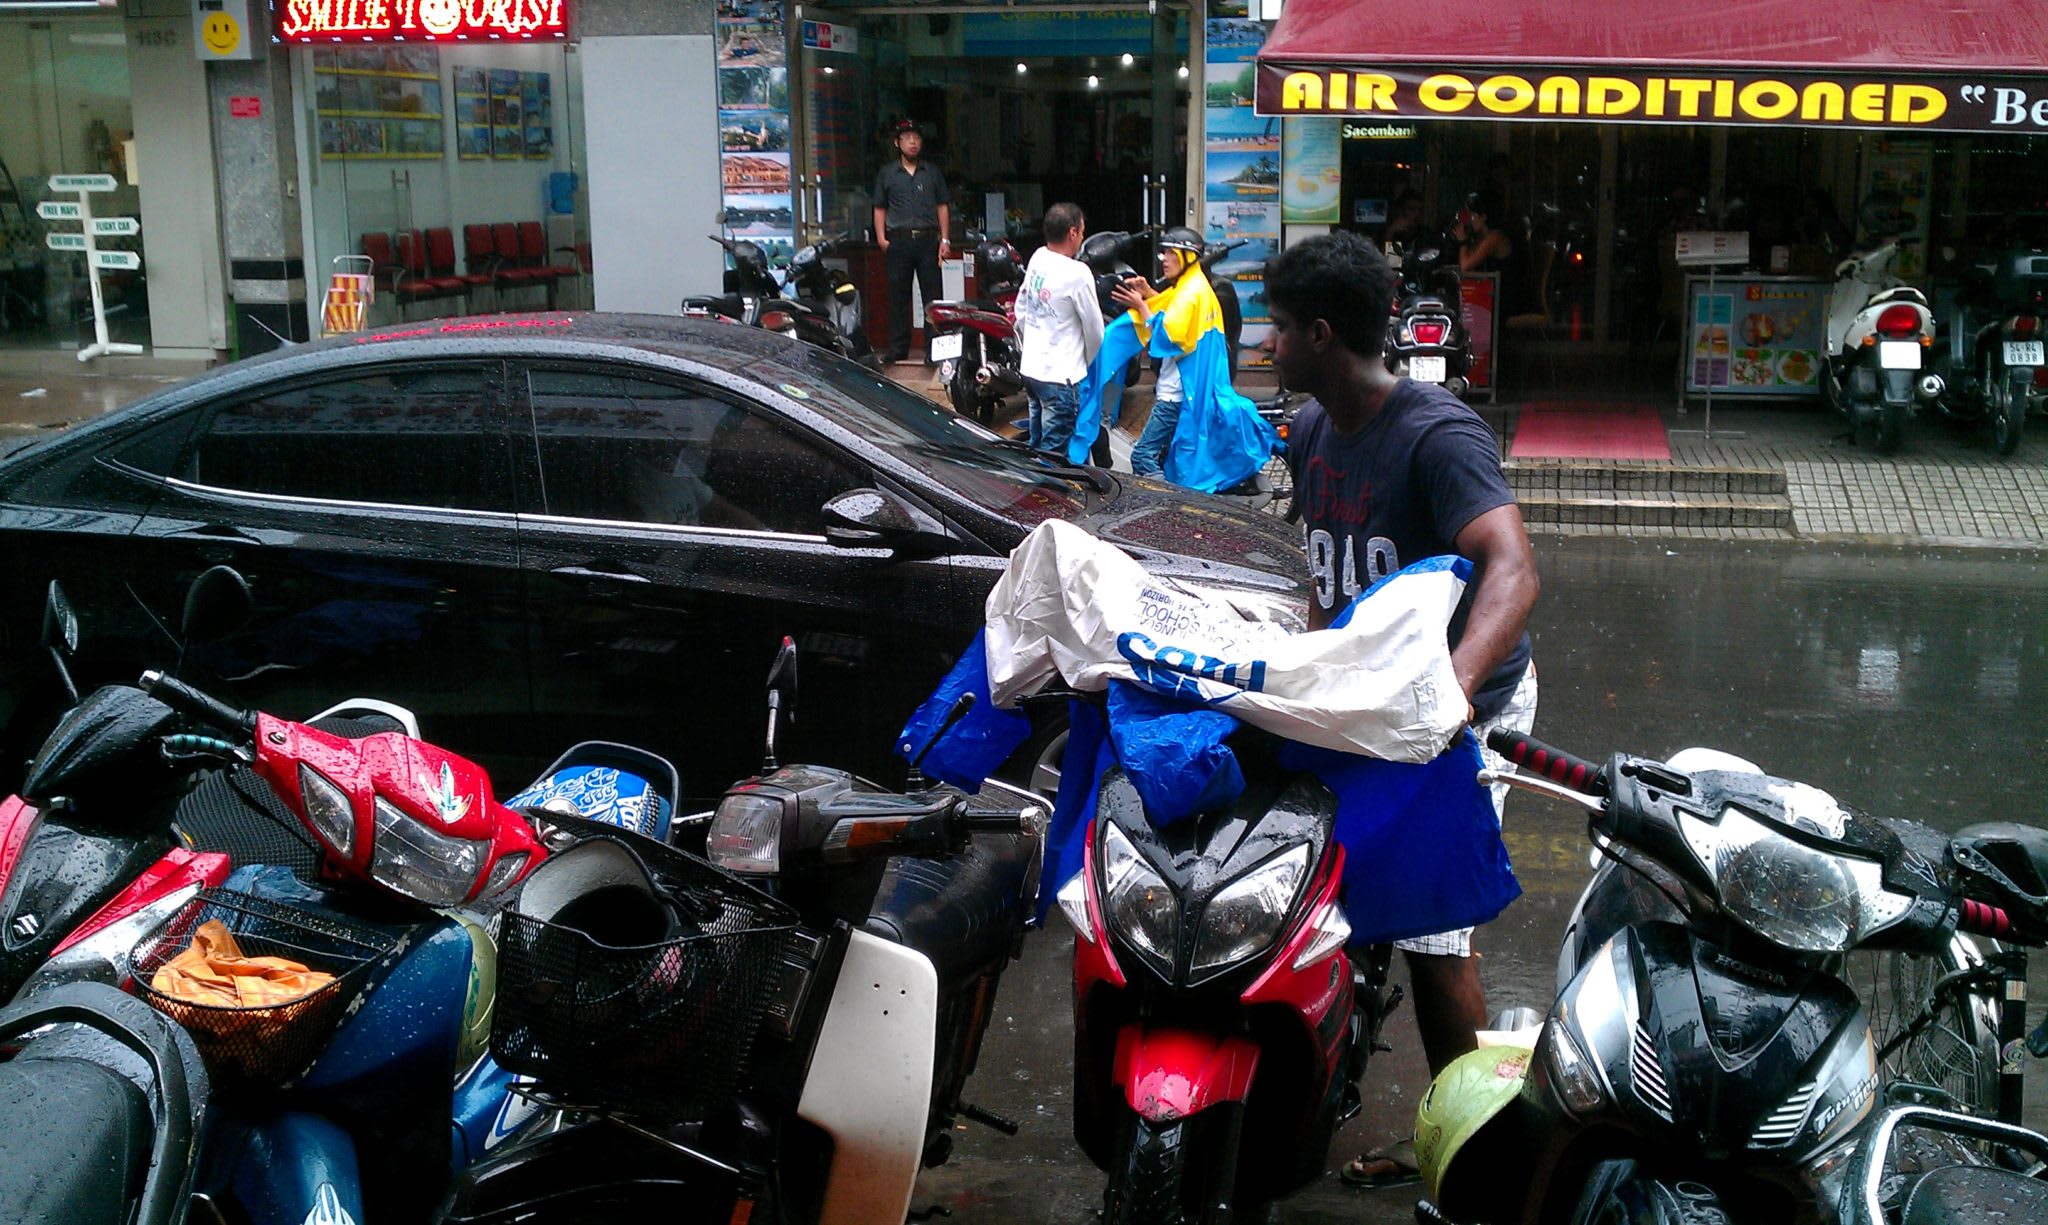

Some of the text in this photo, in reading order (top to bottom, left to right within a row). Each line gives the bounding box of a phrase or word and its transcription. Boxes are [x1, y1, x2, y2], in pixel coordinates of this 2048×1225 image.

[283, 0, 390, 35] SMILE
[1282, 72, 1398, 111] AIR
[1418, 74, 1947, 123] CONDITIONED
[1342, 124, 1416, 139] Sacombank
[43, 205, 79, 216] FREE MAPS
[118, 221, 130, 231] CAR
[1140, 600, 1200, 634] SCHOOL
